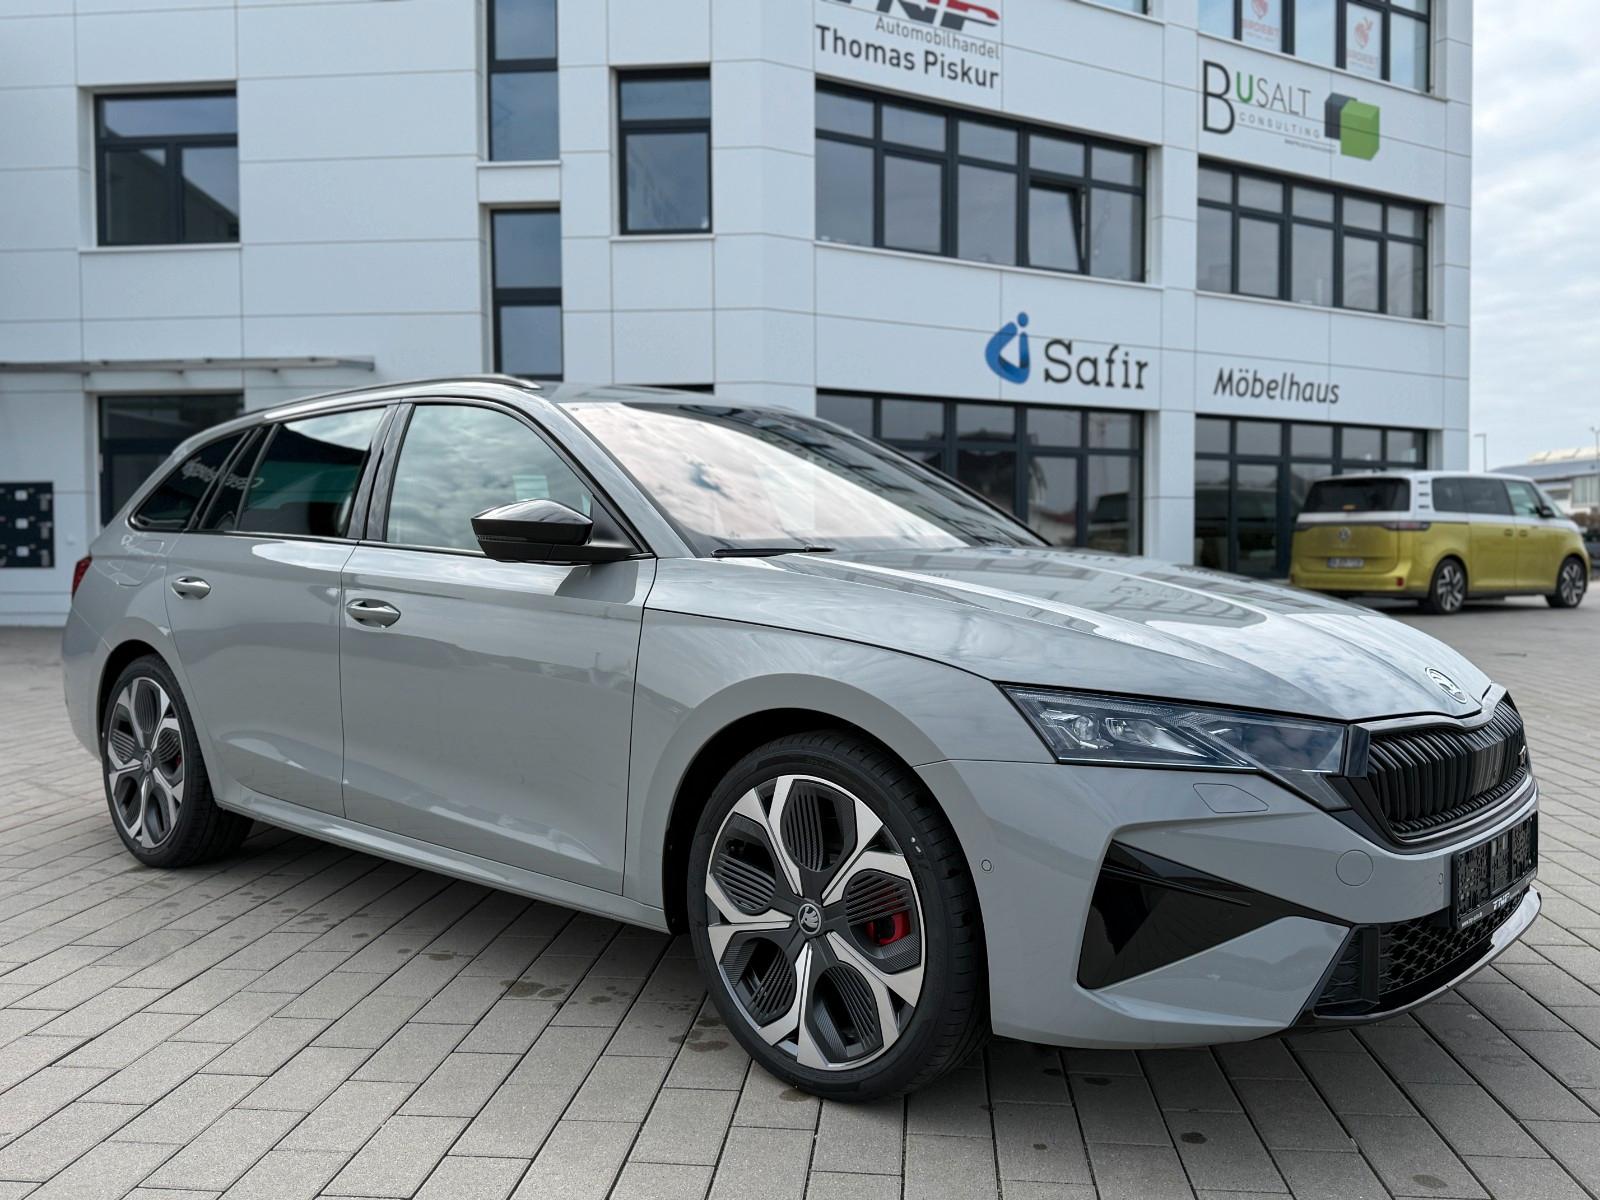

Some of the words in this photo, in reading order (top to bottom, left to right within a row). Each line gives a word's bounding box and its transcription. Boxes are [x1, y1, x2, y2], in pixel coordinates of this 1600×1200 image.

[815, 24, 916, 71] Thomas
[923, 50, 999, 89] Piskur
[875, 16, 1000, 60] Automobilhandel
[1202, 59, 1311, 135] BUSALT
[1239, 111, 1320, 139] CONSULTING
[1044, 339, 1149, 390] Safir
[1213, 367, 1340, 404] Möbelhaus
